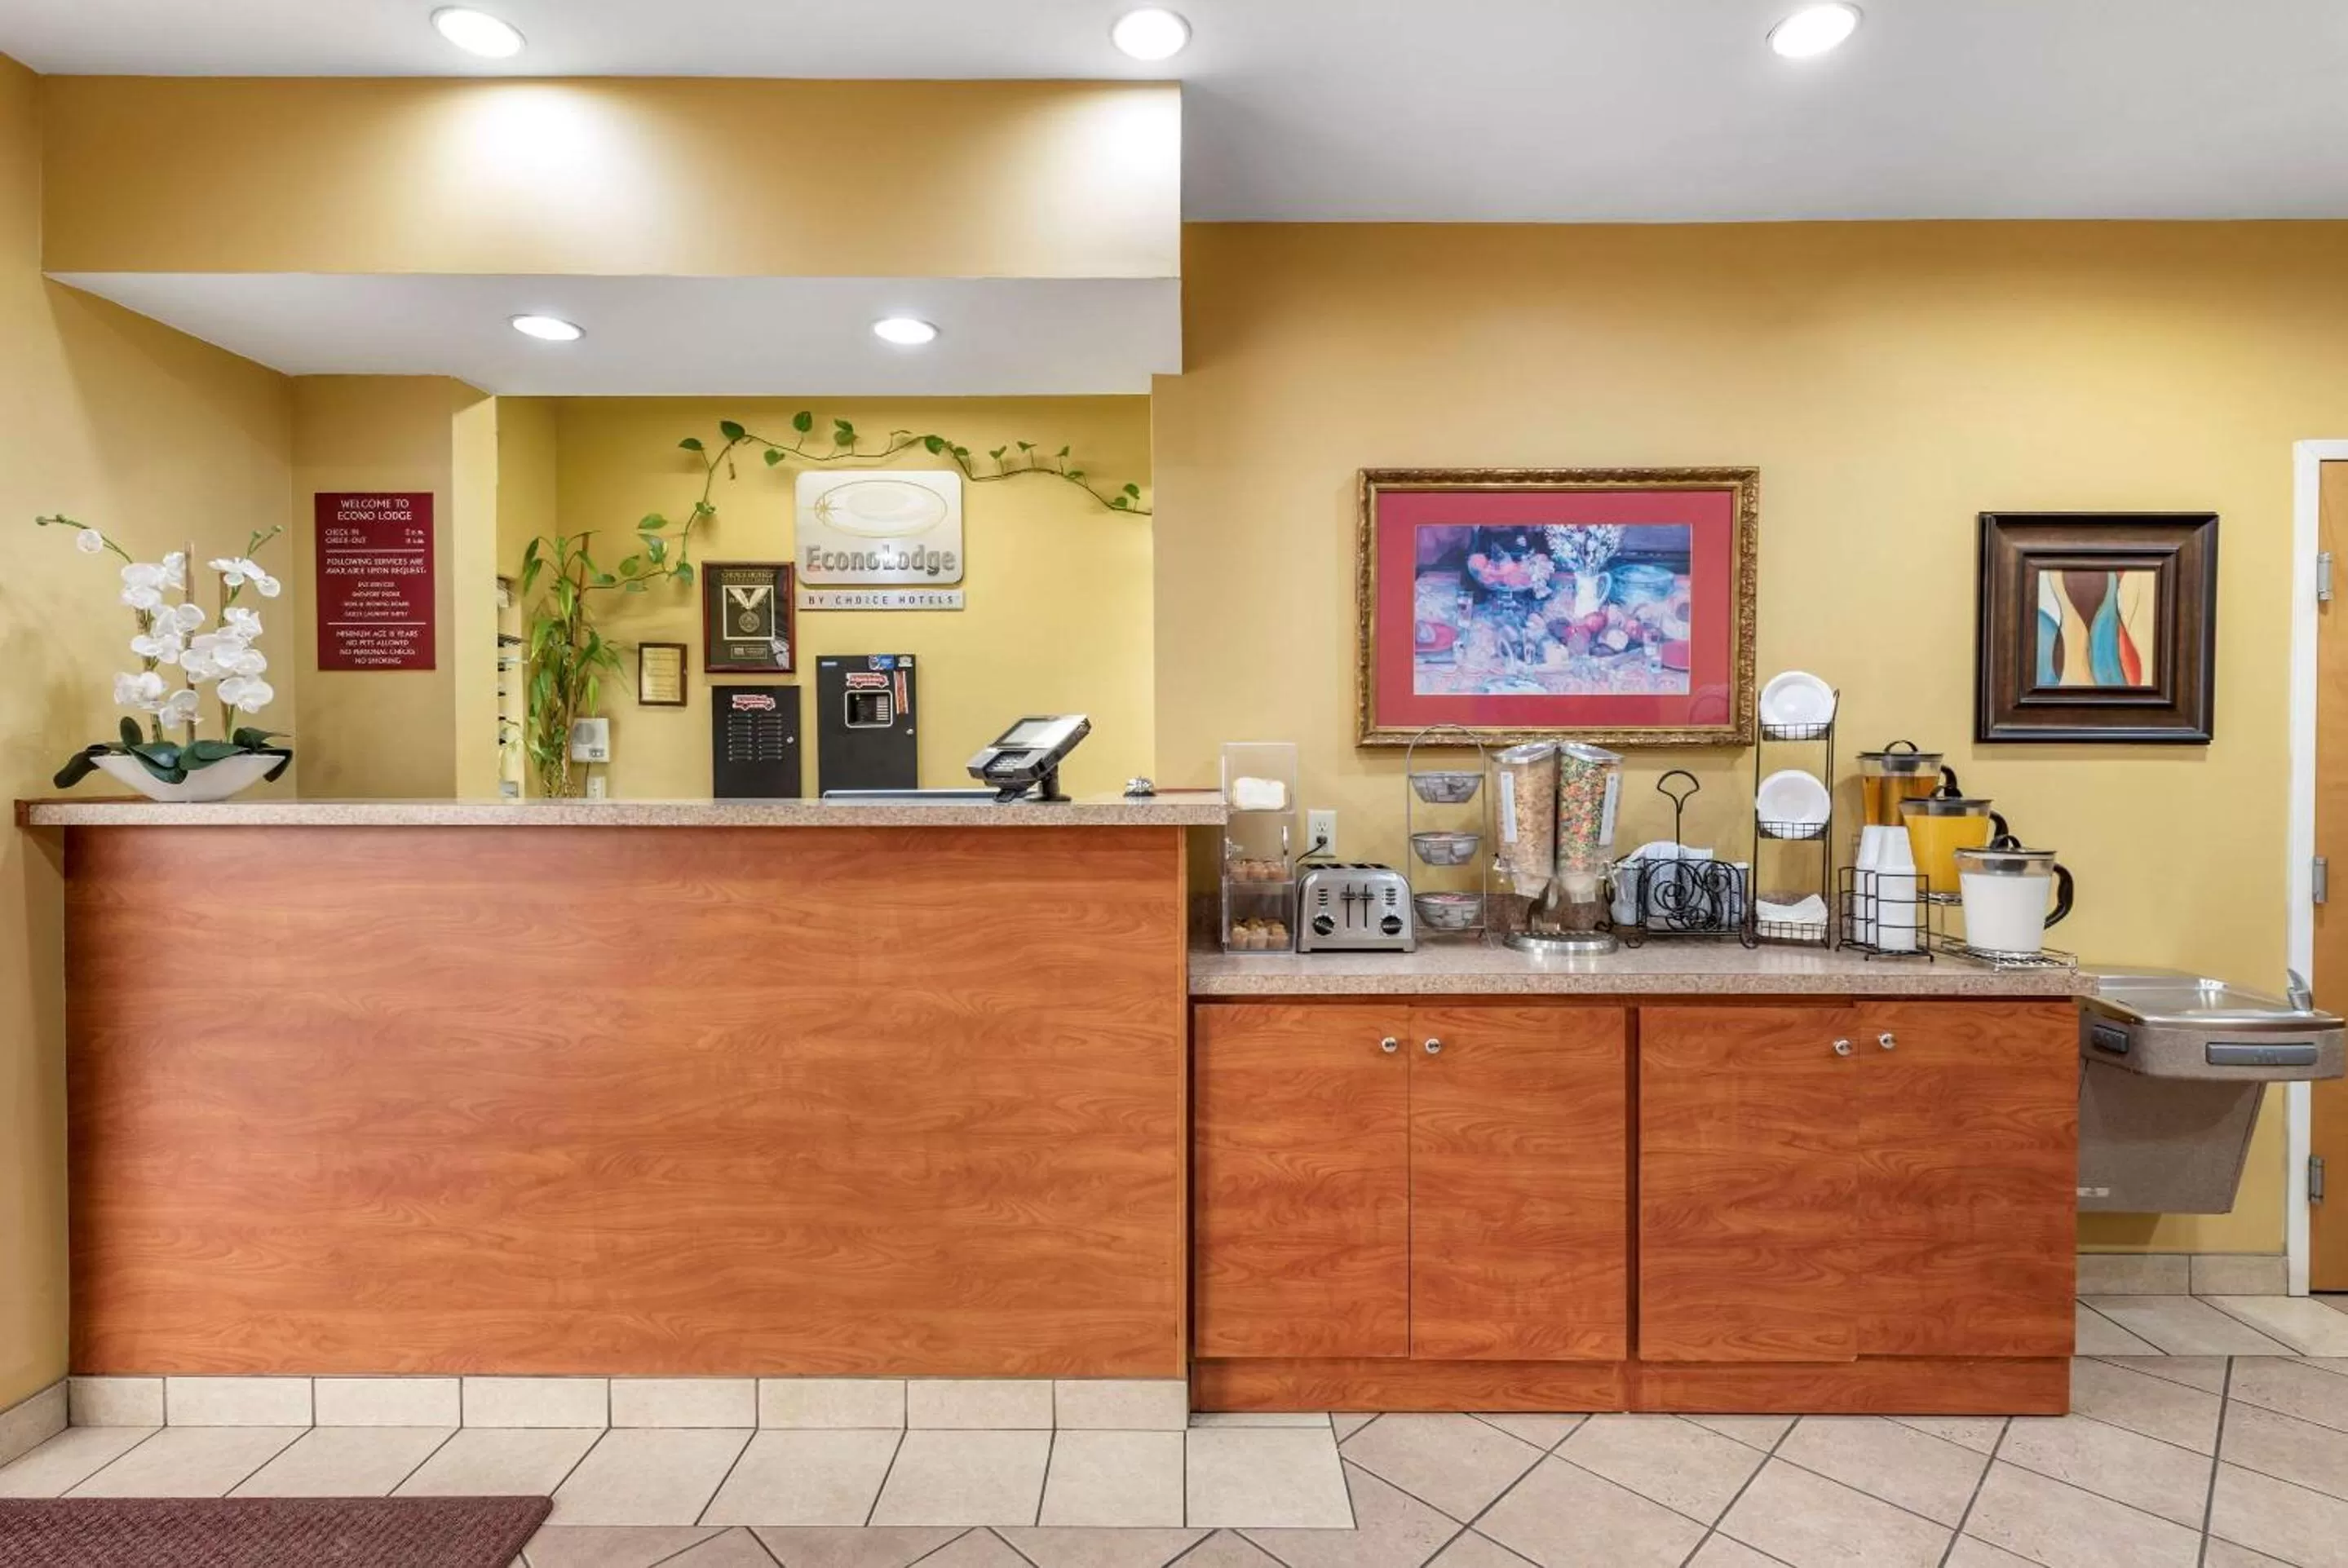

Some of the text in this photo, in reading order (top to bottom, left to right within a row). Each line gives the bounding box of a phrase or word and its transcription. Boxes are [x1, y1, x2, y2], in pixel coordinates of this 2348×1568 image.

[340, 498, 409, 509] WELCOME TO
[338, 511, 412, 520] ECONO LODGE
[808, 595, 954, 605] BY CHOICE HOTELS
[354, 656, 368, 665] NO
